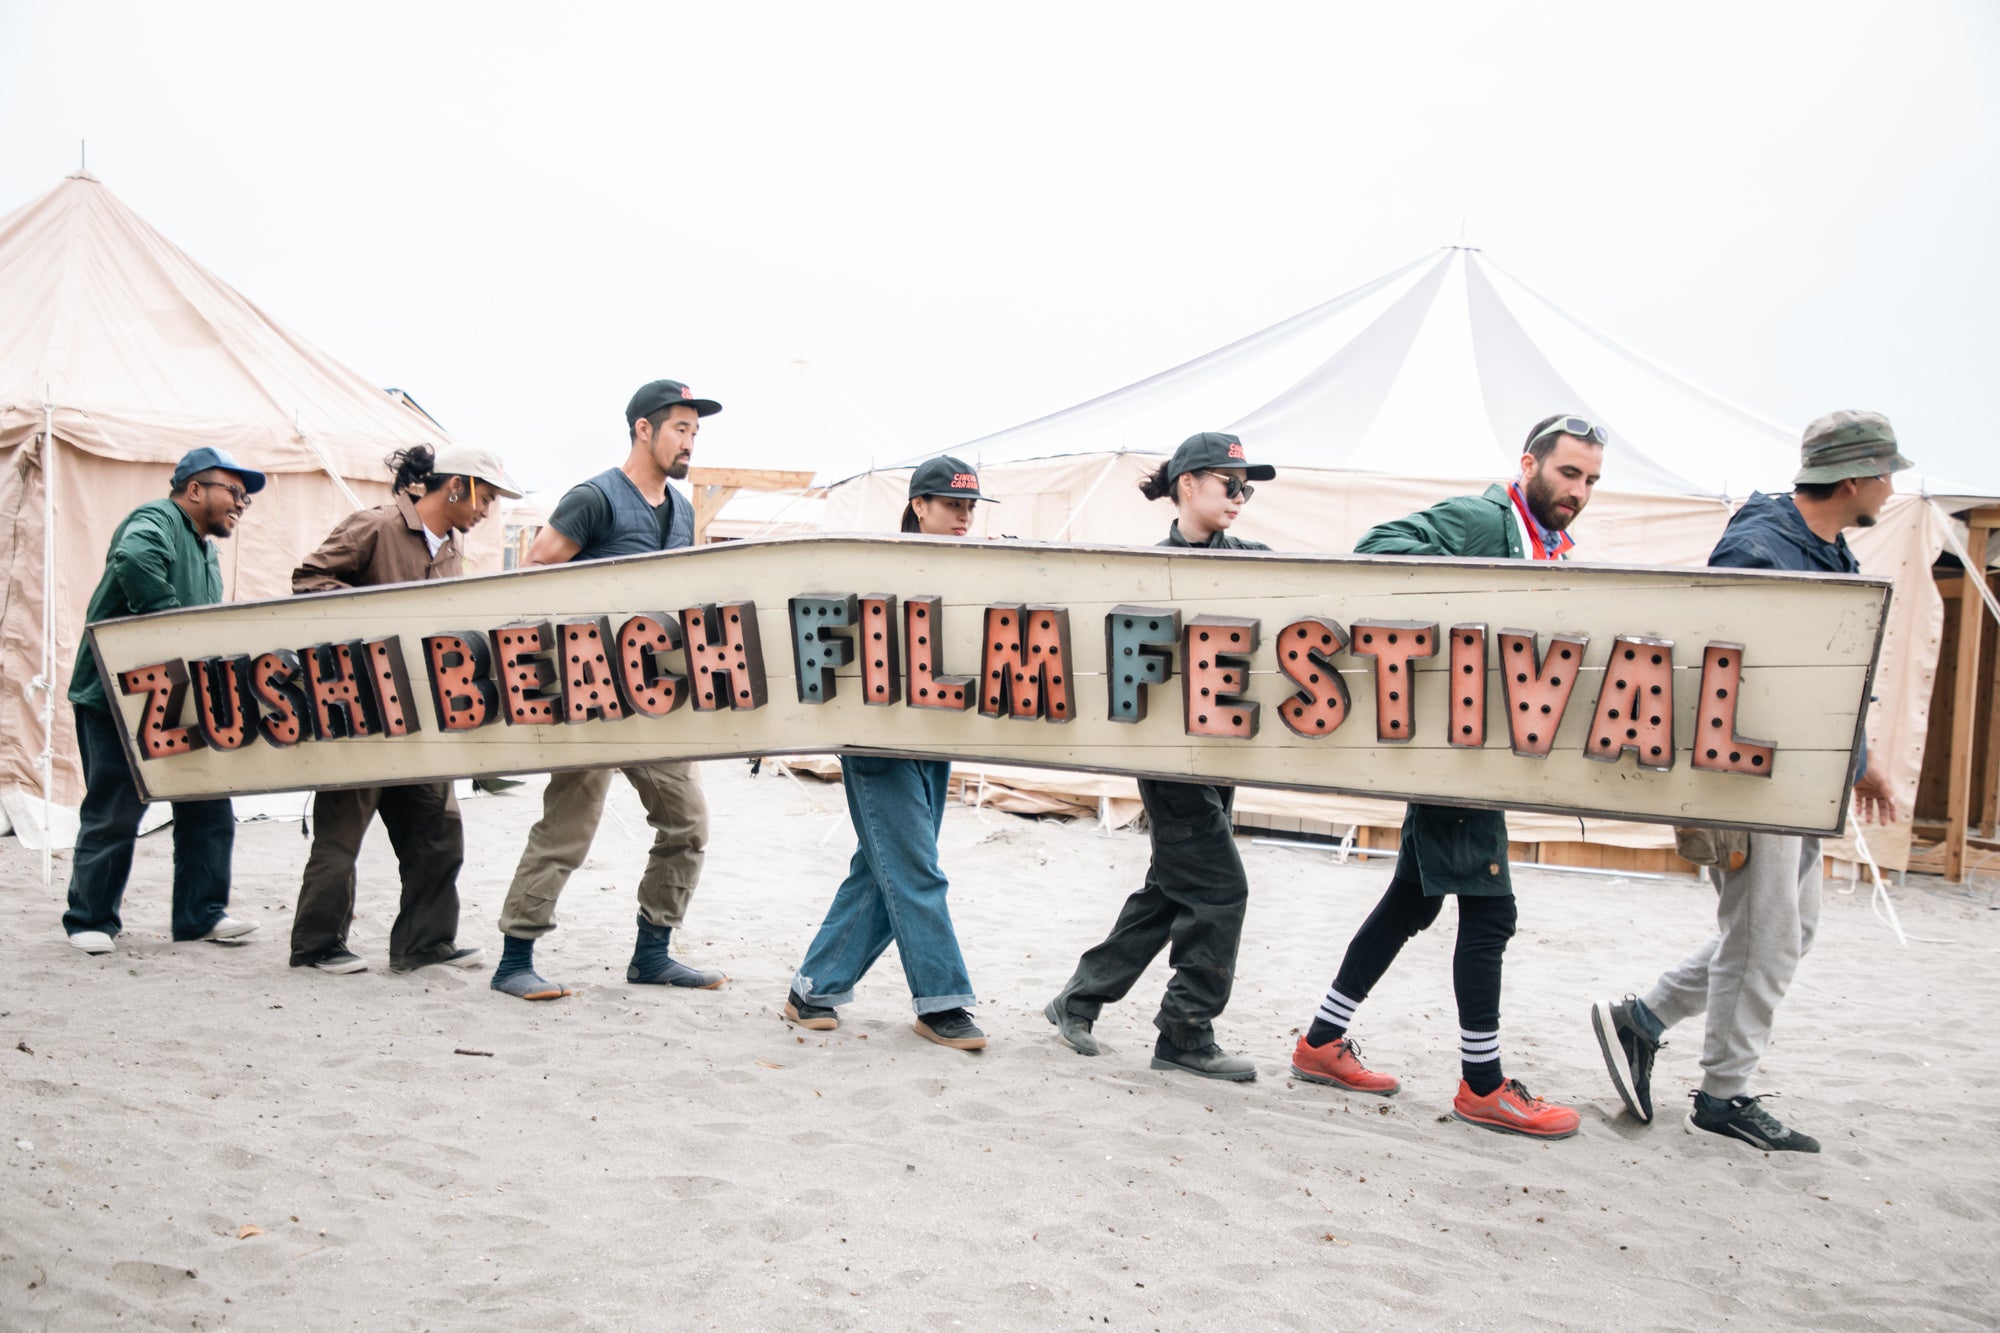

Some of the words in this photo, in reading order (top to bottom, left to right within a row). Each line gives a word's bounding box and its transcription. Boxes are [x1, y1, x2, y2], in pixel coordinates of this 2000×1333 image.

[117, 635, 421, 761] ZUSHI
[421, 600, 769, 733] BEACH
[788, 593, 1077, 724] FILM
[1105, 604, 1777, 778] FESTIVAL
